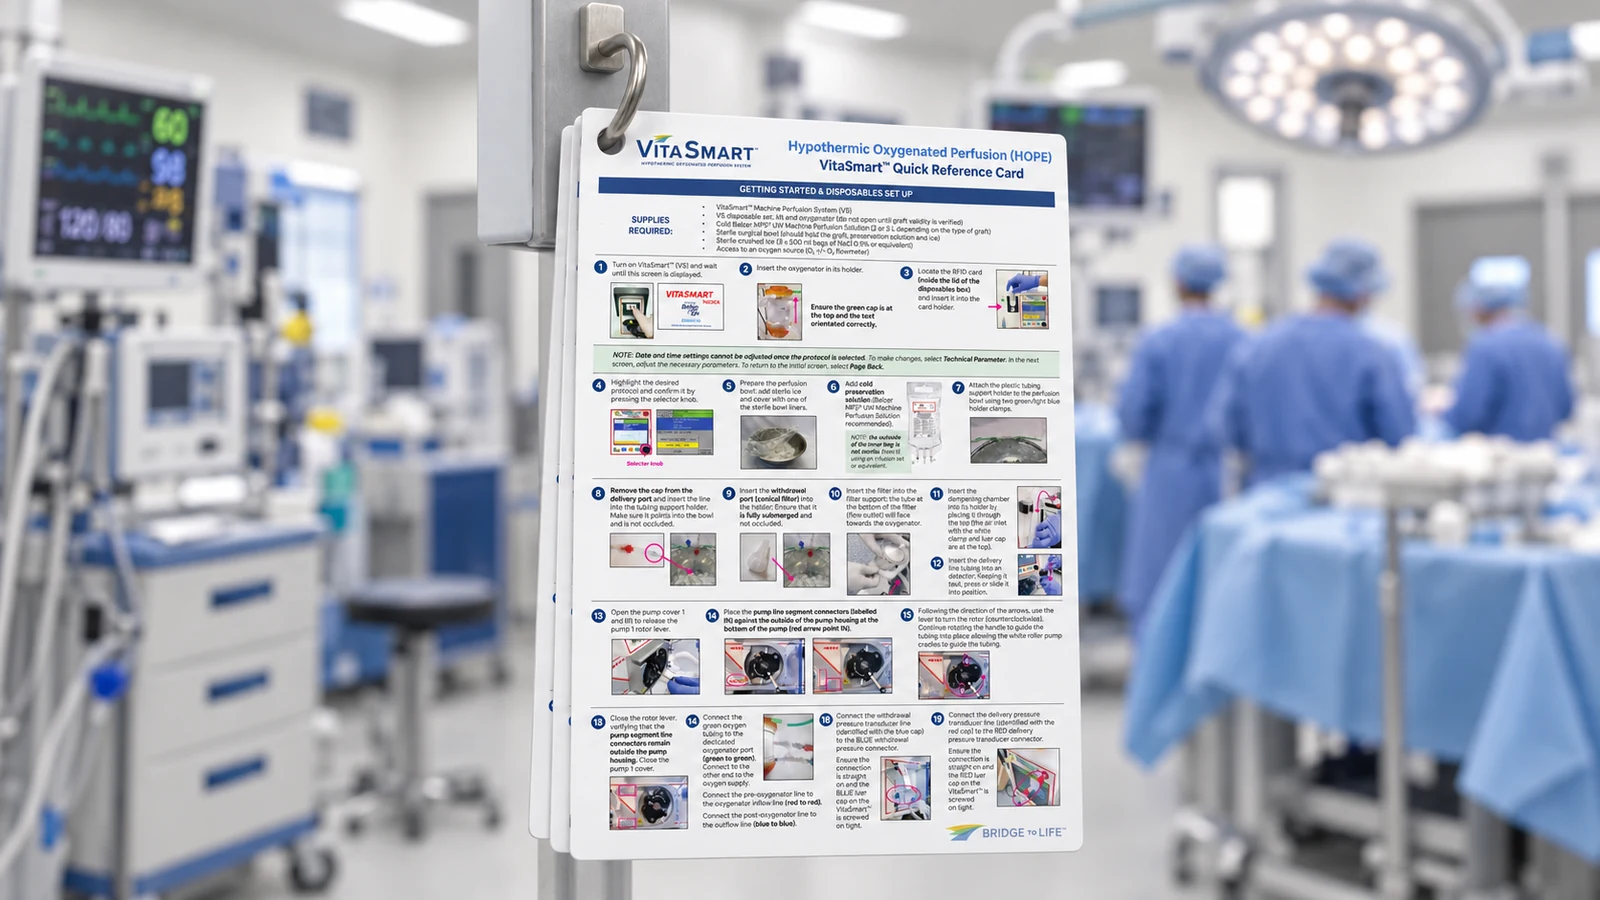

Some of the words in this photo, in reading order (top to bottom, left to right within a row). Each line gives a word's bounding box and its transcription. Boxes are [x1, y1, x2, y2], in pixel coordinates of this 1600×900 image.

[788, 140, 869, 154] Hypothermic
[873, 144, 947, 159] Oxygenated
[951, 147, 1007, 160] Perfusion
[1011, 150, 1052, 163] (HOPE)
[893, 162, 928, 175] Quick
[932, 164, 992, 177] Reference
[996, 167, 1024, 179] Card
[740, 185, 777, 193] GETTING
[779, 186, 816, 195] STARTED
[818, 187, 824, 195] &
[826, 188, 883, 197] DISPOSABLES
[902, 190, 913, 198] UP
[632, 216, 670, 224] SUPPLIES
[629, 227, 672, 235] REQUIRED:
[666, 290, 713, 298] VITASMART
[846, 321, 877, 329] correctly.
[983, 828, 1024, 838] BRIDGE
